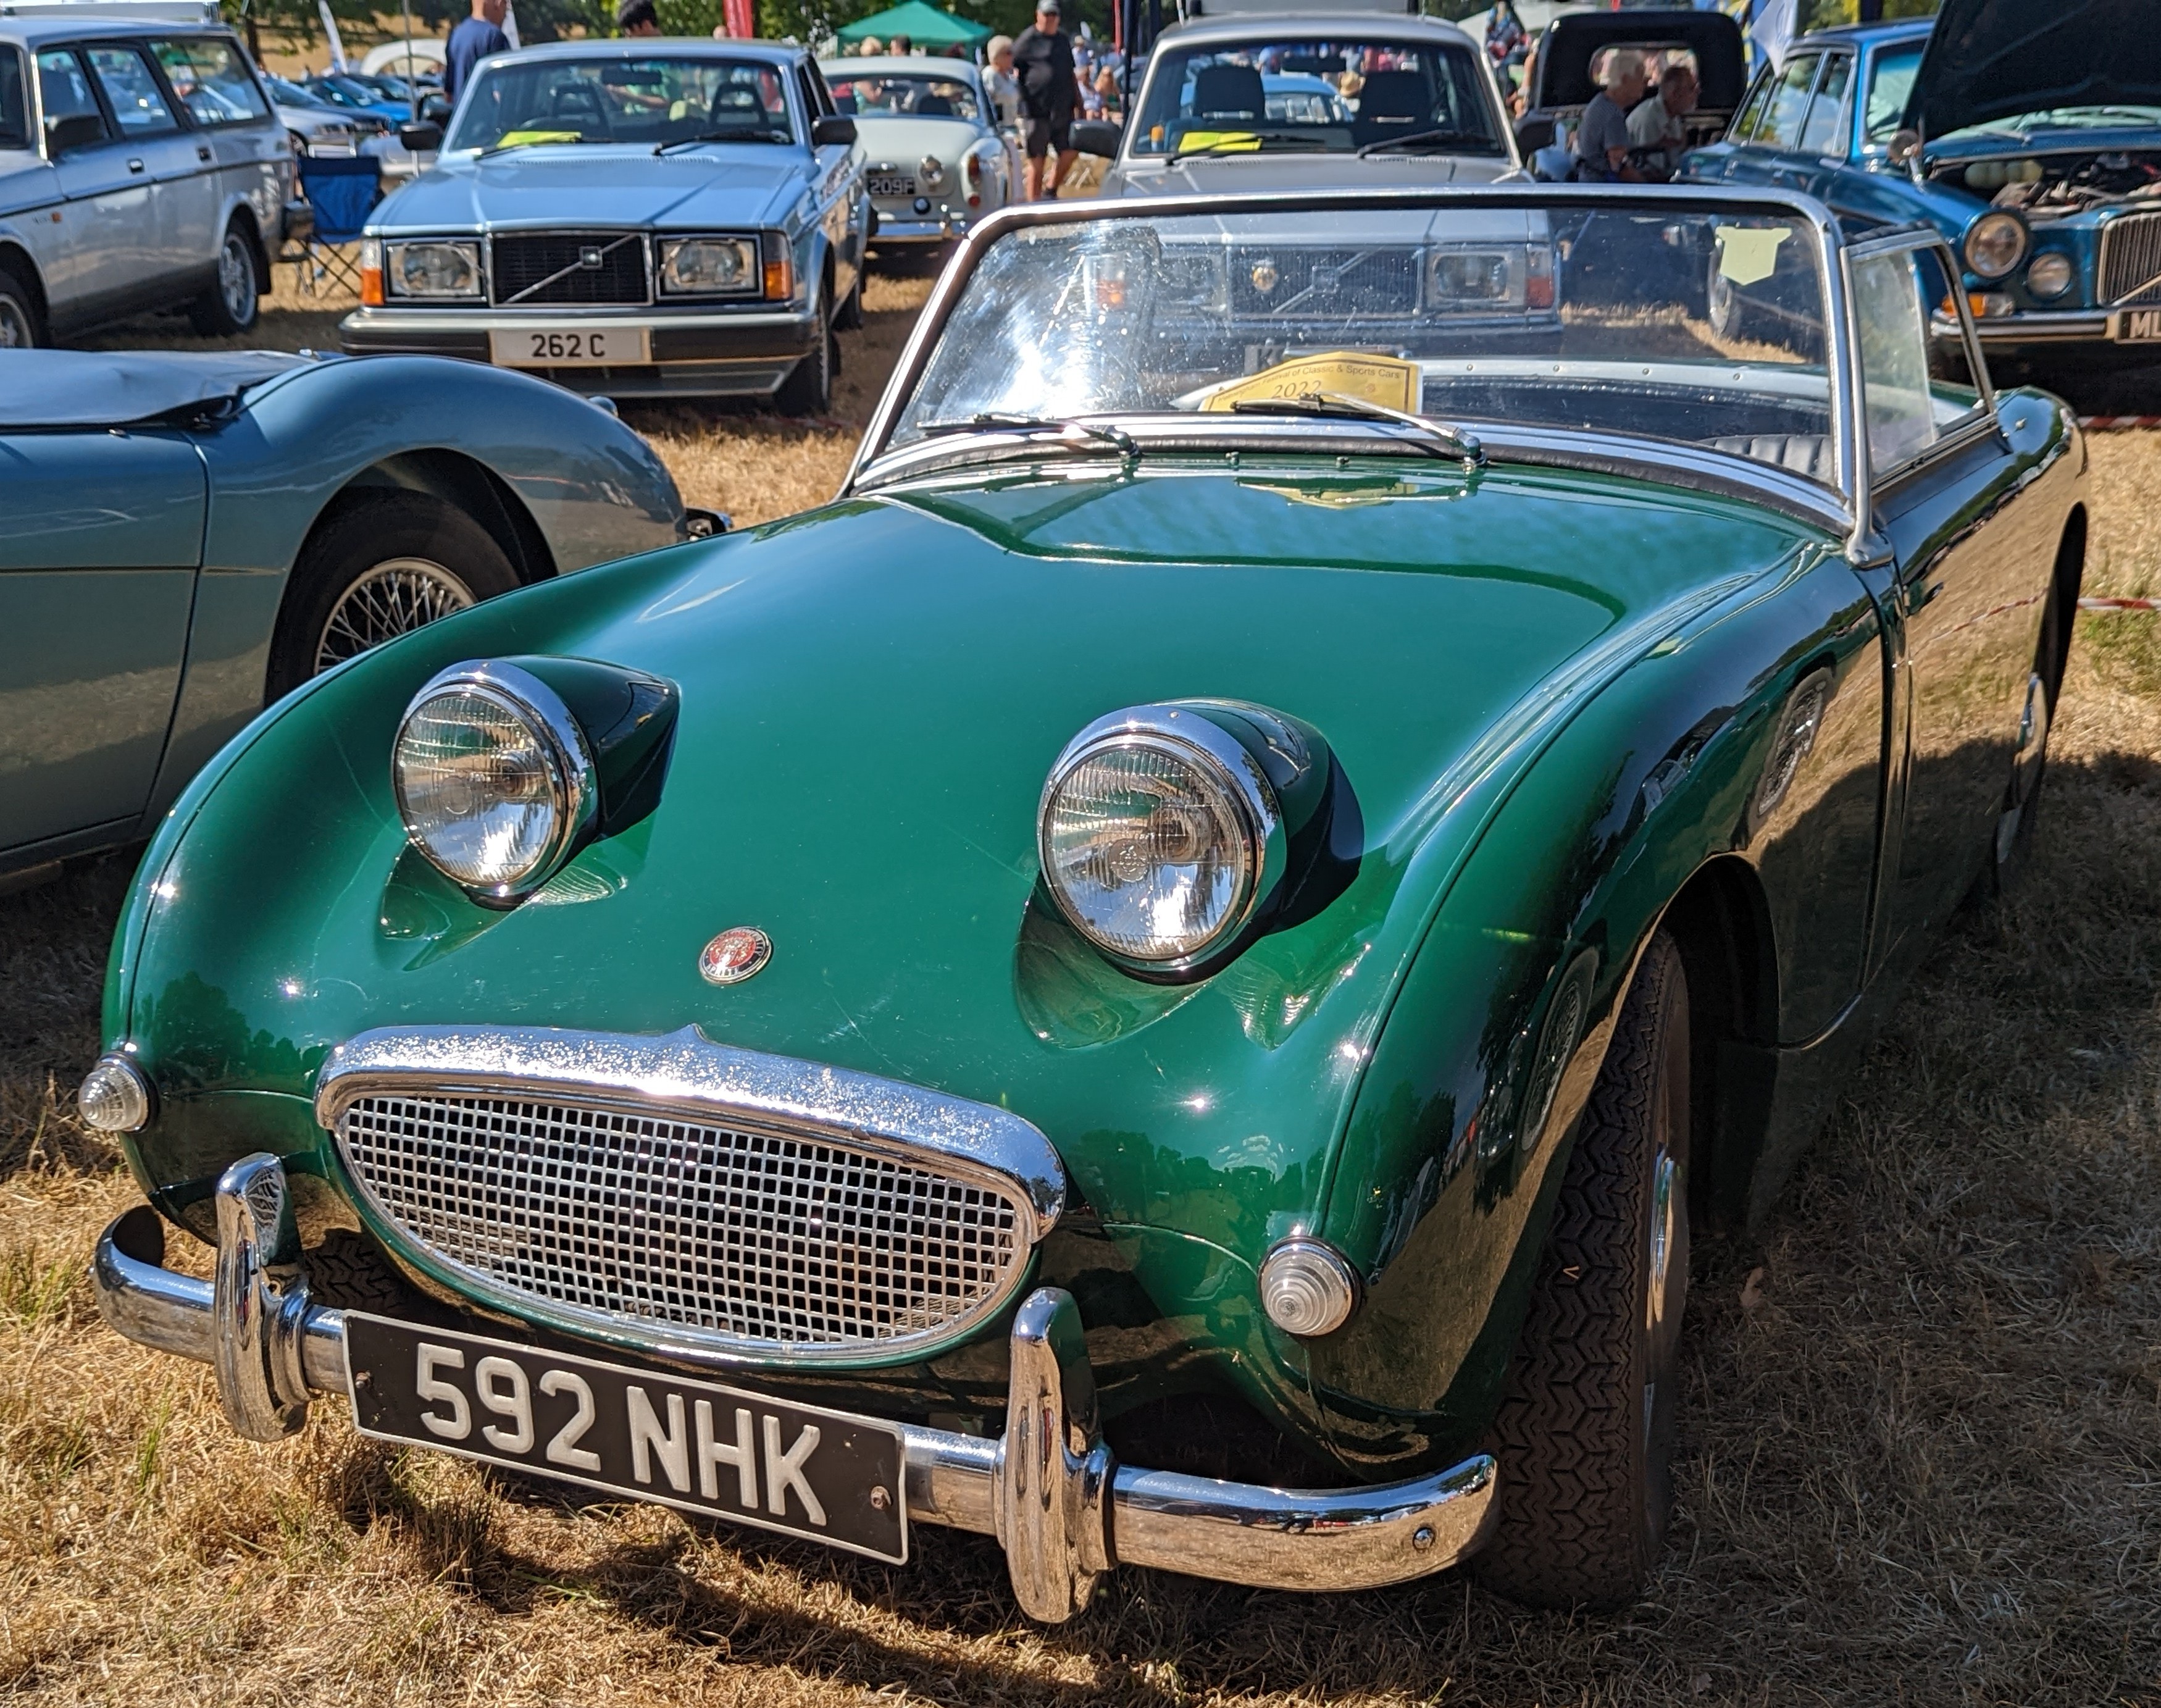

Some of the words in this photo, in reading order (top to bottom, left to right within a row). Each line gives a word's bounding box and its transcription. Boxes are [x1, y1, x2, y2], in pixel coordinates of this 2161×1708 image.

[531, 333, 582, 358] 262
[590, 333, 605, 358] C
[1292, 368, 1301, 376] of
[1302, 366, 1334, 375] Classic
[1336, 364, 1343, 373] &
[1346, 365, 1376, 376] Sports
[1378, 369, 1400, 379] Cars
[1271, 380, 1321, 399] 2022
[416, 1341, 601, 1473] 592
[626, 1385, 827, 1526] NHK
